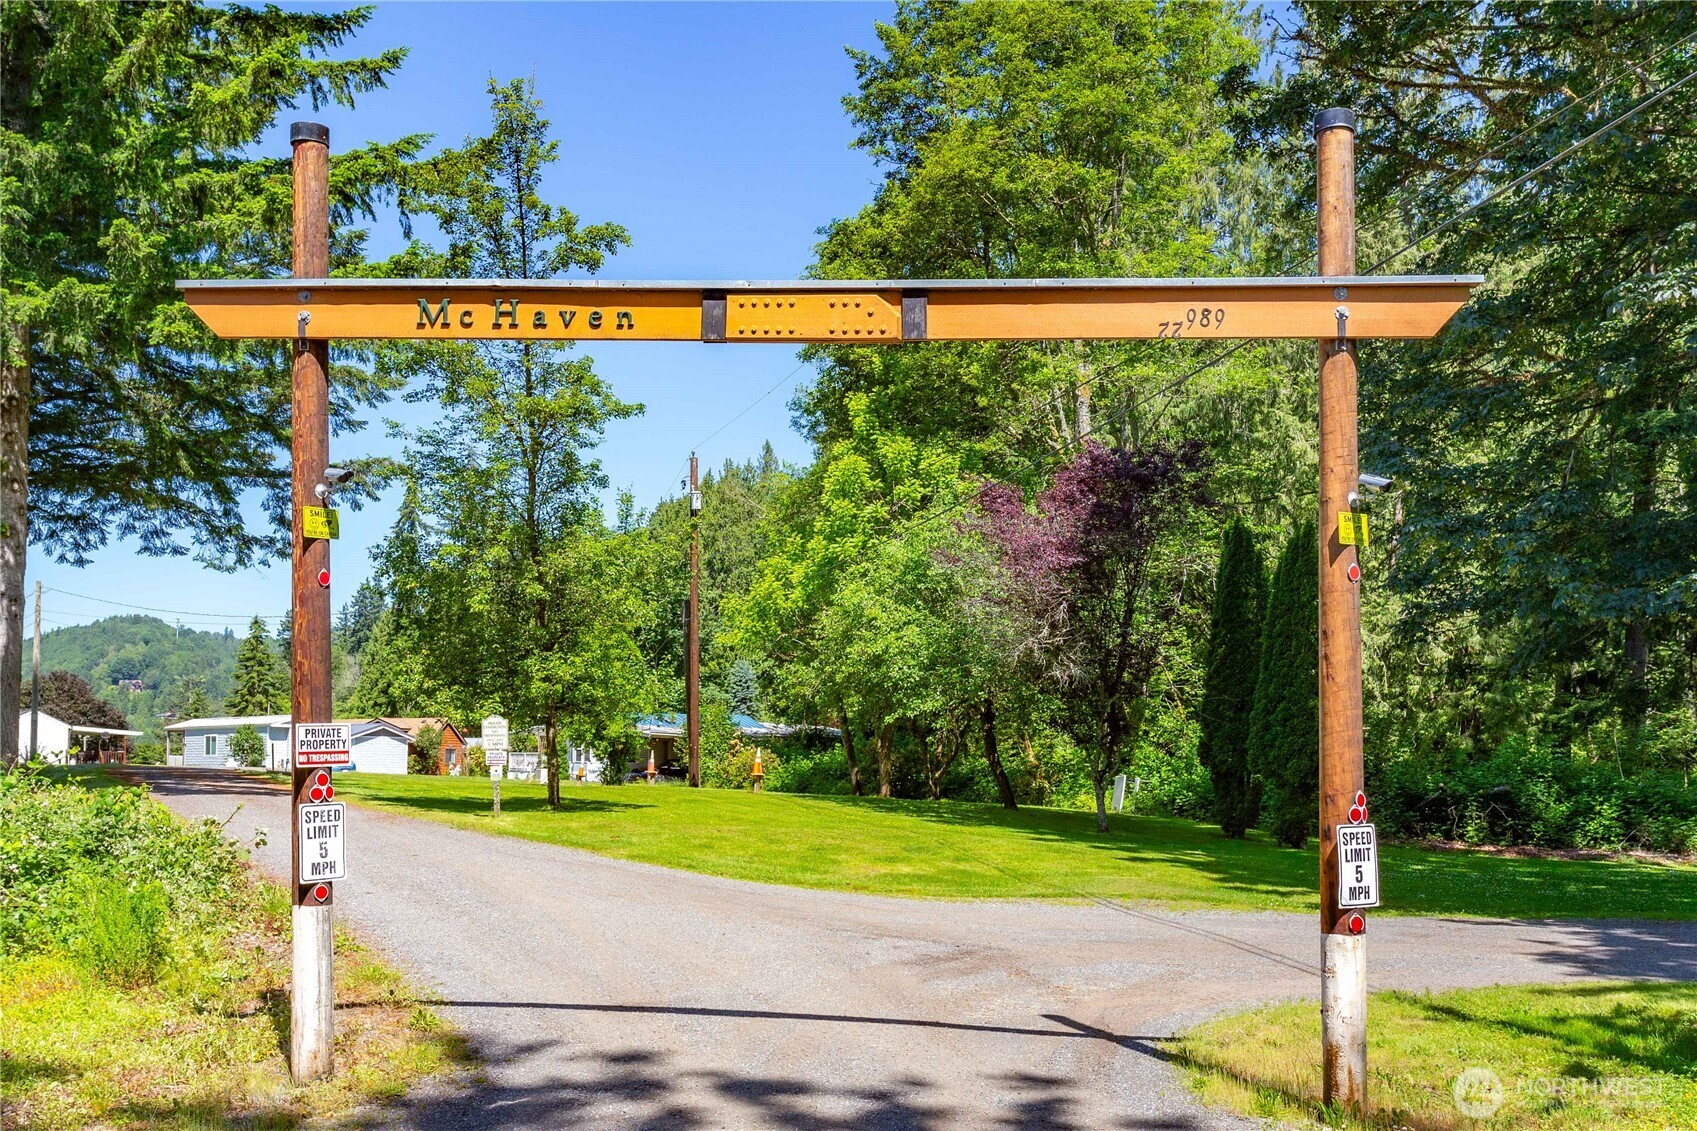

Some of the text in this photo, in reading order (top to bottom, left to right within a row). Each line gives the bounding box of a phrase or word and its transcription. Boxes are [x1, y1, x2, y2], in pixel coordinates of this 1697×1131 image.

[305, 728, 342, 738] PRIVATE
[300, 739, 347, 750] PROPERTY
[299, 753, 349, 763] NO TRESPASSING
[305, 809, 341, 824] SPEED
[307, 824, 339, 840] LIMIT
[1342, 831, 1372, 846] SPEED
[319, 841, 329, 859] 5
[1344, 848, 1371, 863] LIMIT
[311, 860, 337, 876] MPH
[1355, 865, 1363, 884] 5
[1349, 885, 1370, 901] MPH
